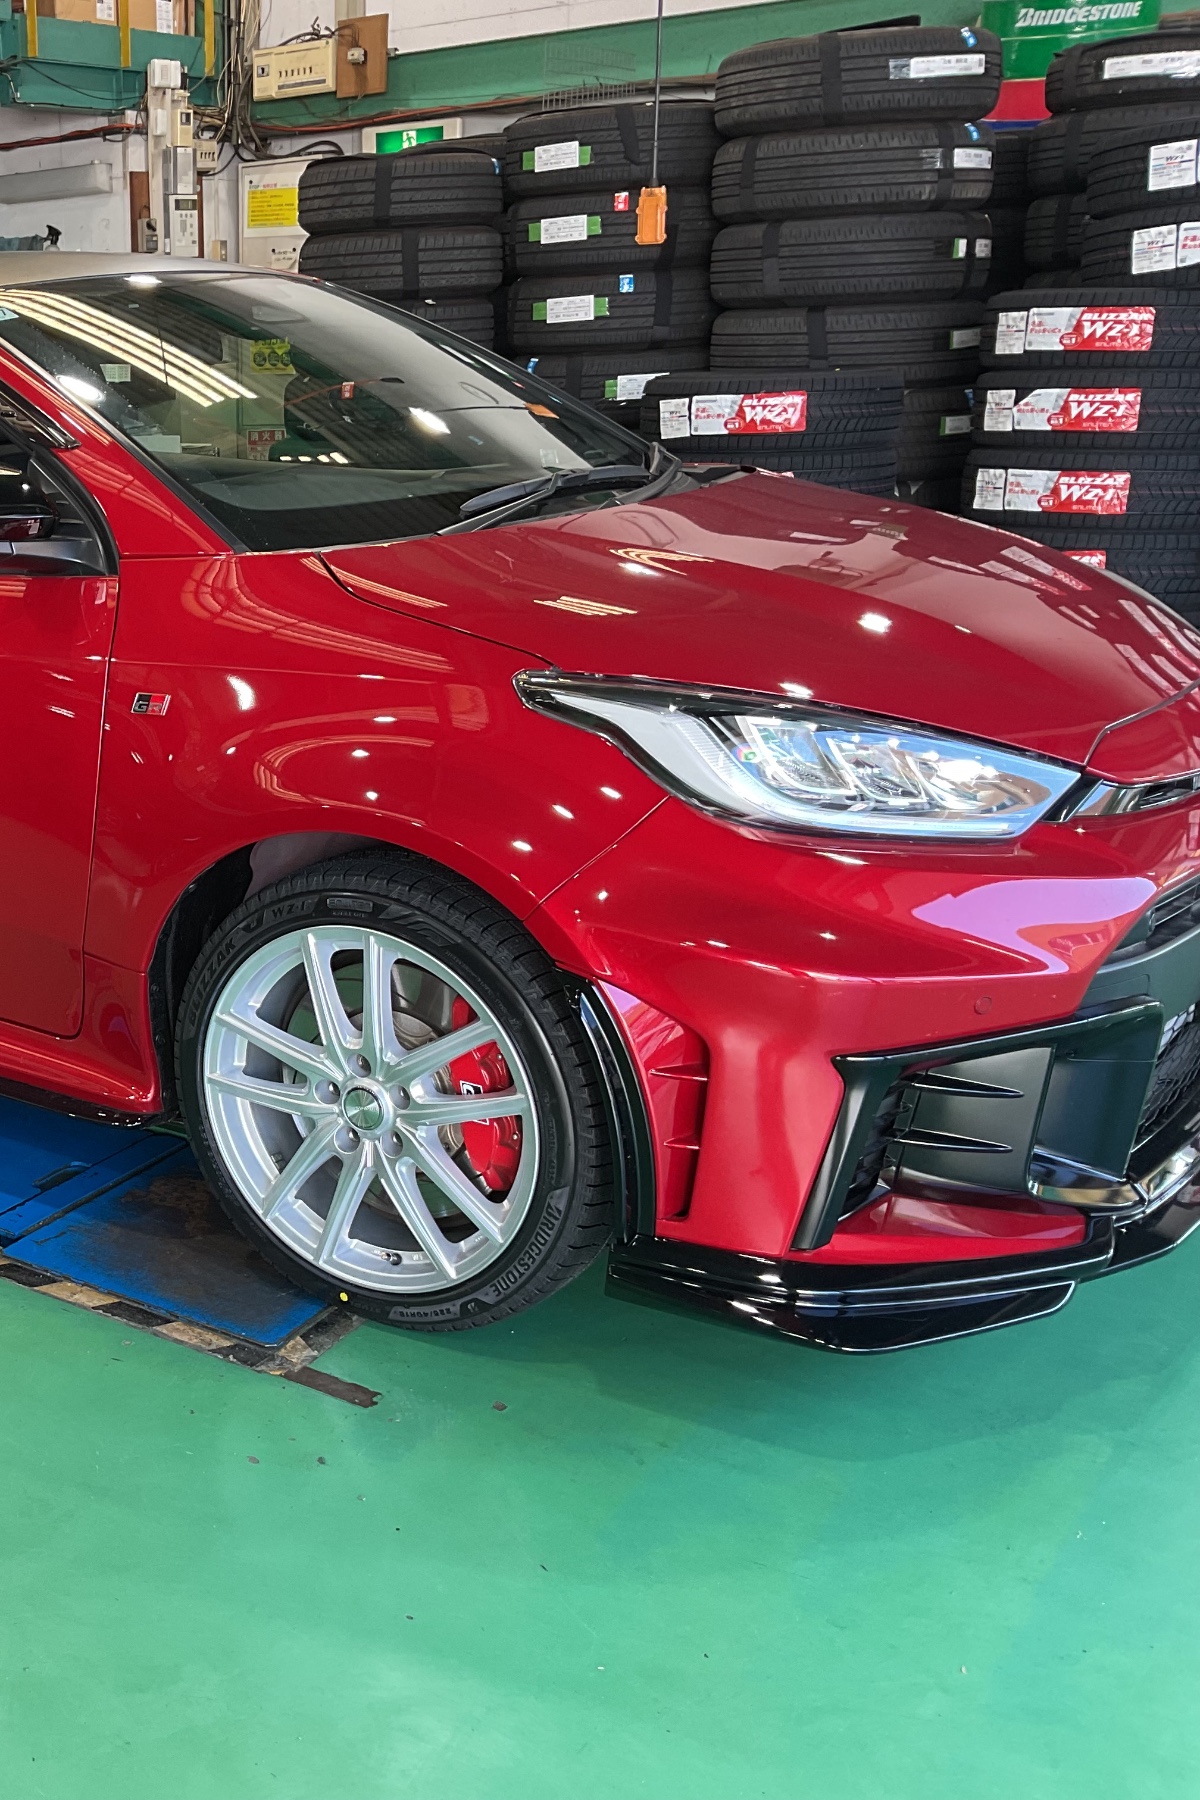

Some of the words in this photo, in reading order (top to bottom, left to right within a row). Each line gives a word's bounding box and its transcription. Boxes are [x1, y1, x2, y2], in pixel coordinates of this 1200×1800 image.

[1014, 2, 1141, 28] BRIDGESTONE
[1081, 312, 1151, 321] BLIZZAK
[1068, 393, 1136, 401] BLIZZAK
[1069, 402, 1128, 419] WZ-1
[1058, 474, 1126, 485] BLIZZAK
[133, 700, 163, 713] GR
[188, 938, 237, 1027] BLIZZAK
[489, 1202, 563, 1298] BRIDGESTONE
